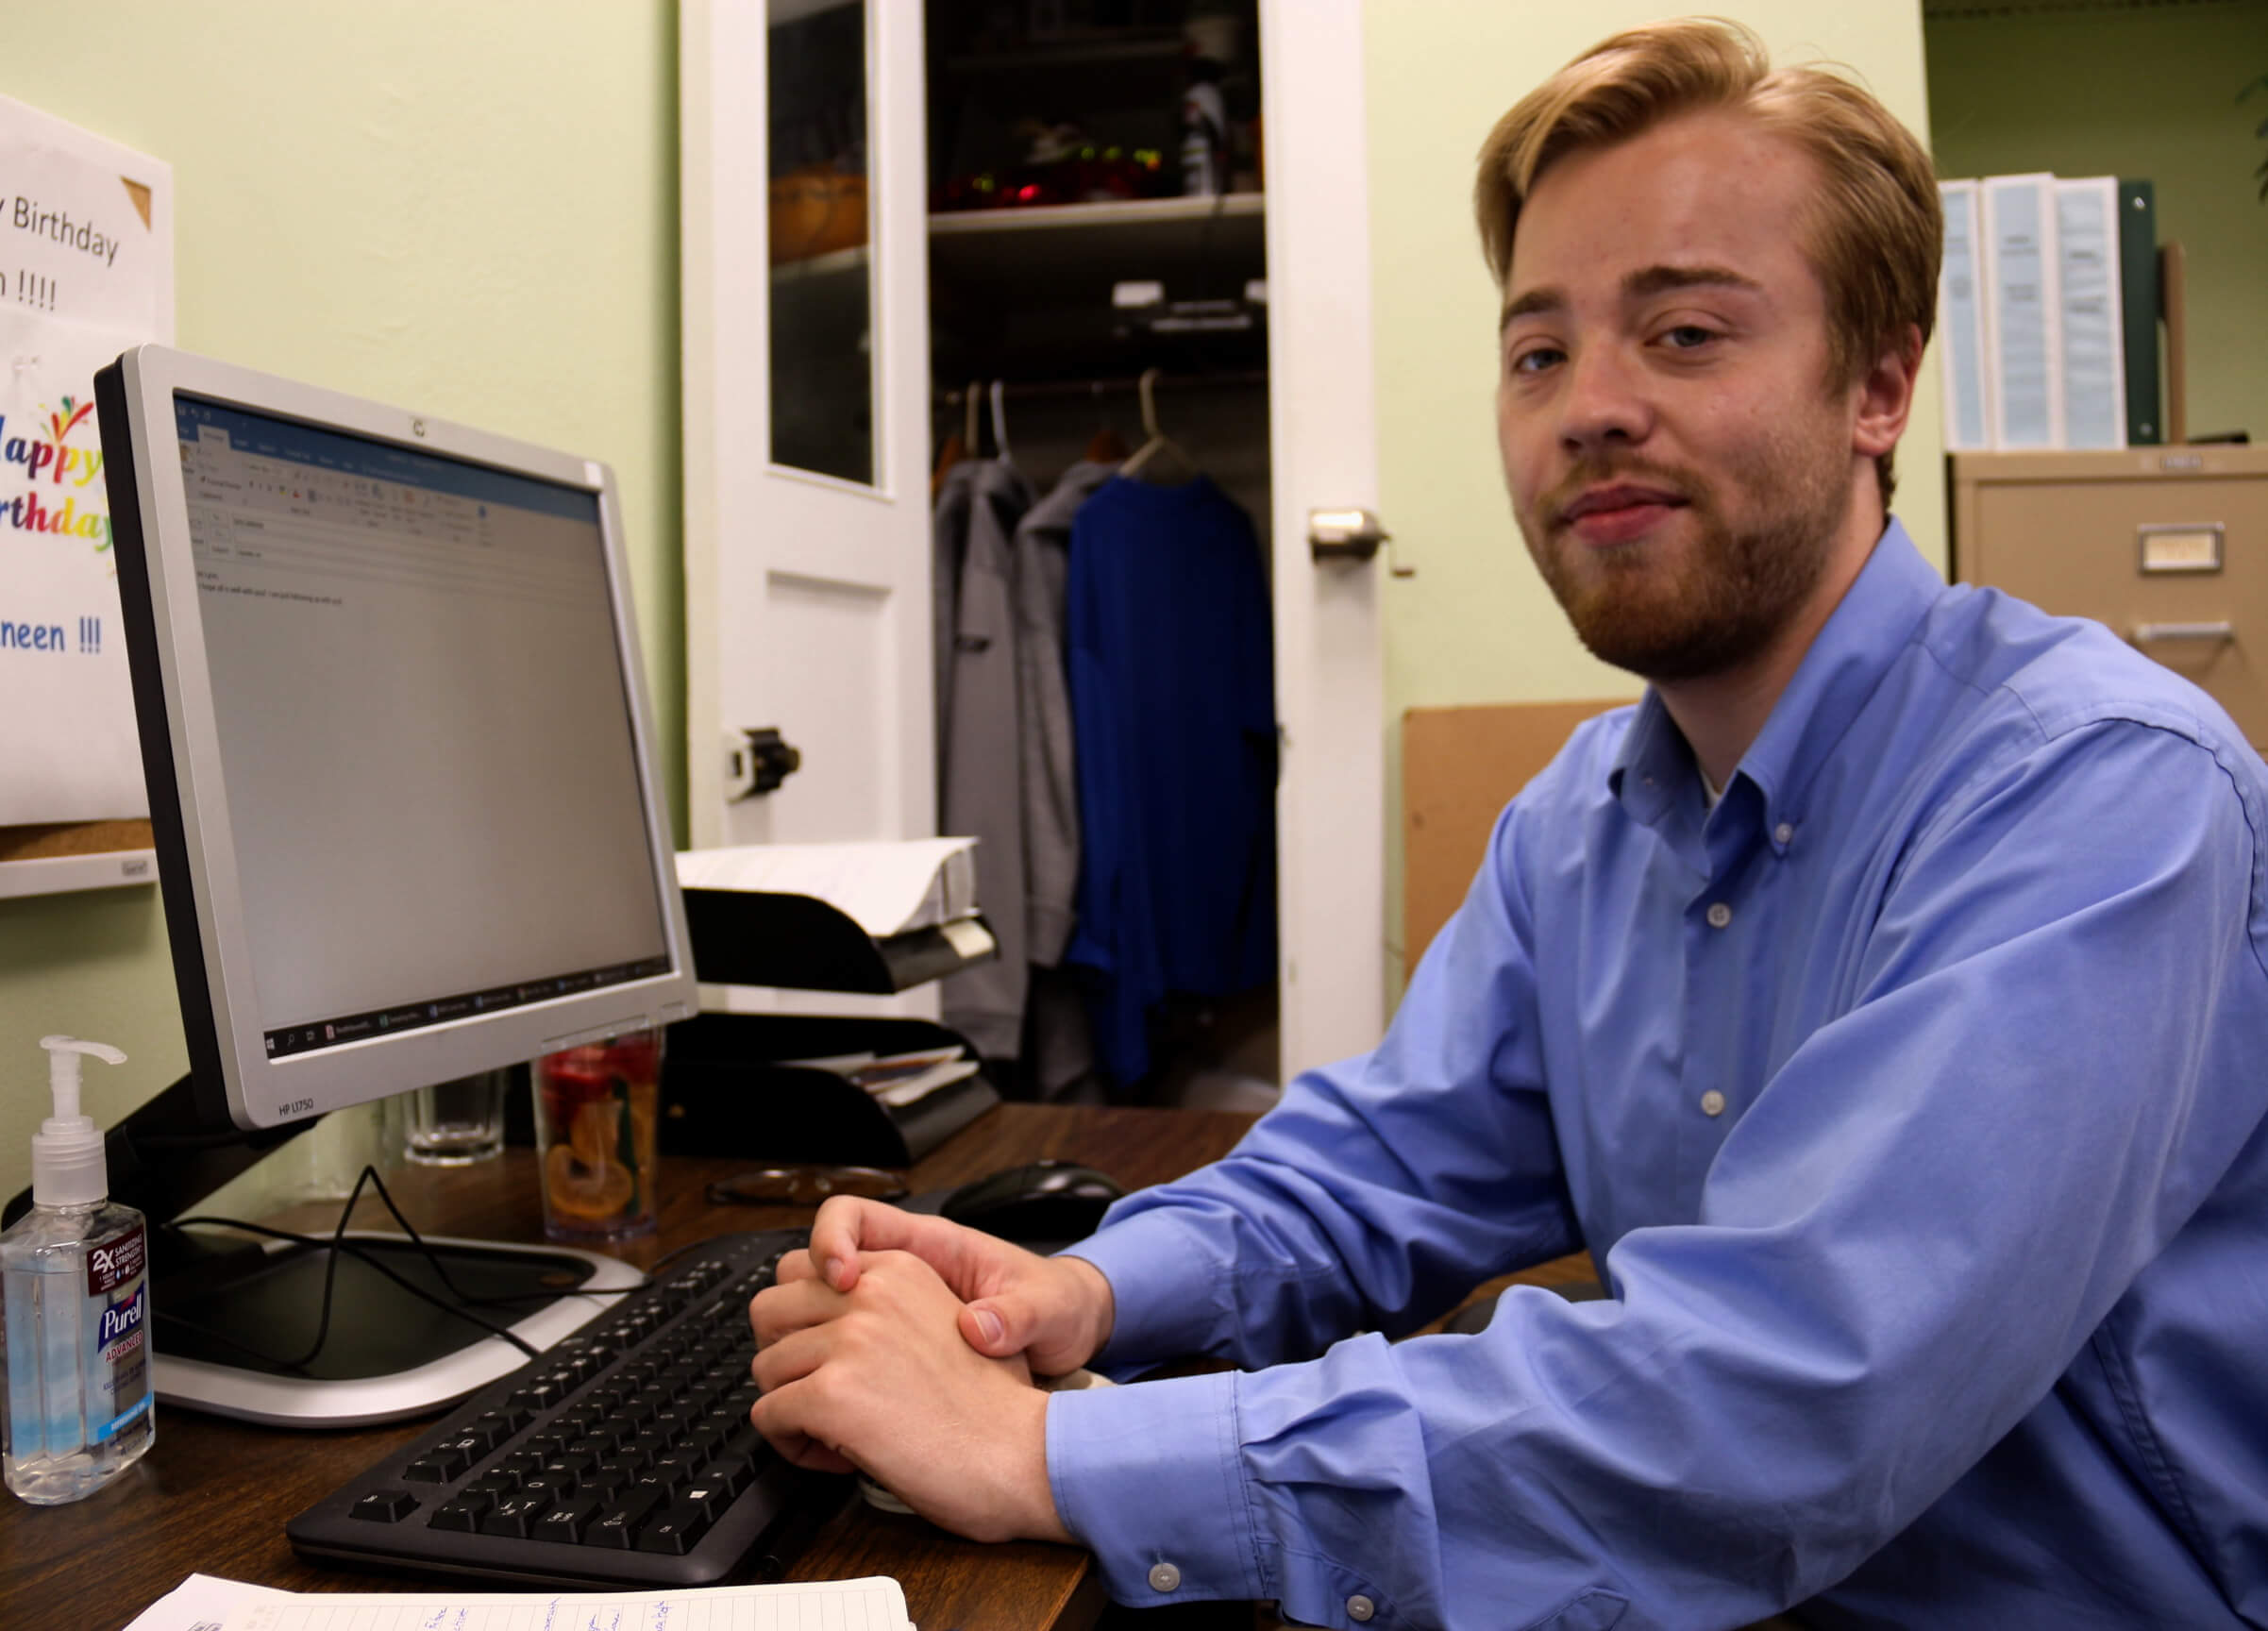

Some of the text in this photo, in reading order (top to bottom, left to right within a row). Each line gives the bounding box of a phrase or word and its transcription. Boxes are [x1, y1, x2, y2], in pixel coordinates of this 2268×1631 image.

[14, 196, 119, 268] Birthday
[19, 269, 56, 311] !!!!
[79, 615, 100, 654] !!!
[279, 1103, 290, 1118] HP
[92, 1249, 115, 1273] 2X
[105, 1292, 142, 1339] Purell
[106, 1329, 143, 1363] ADVANCED
